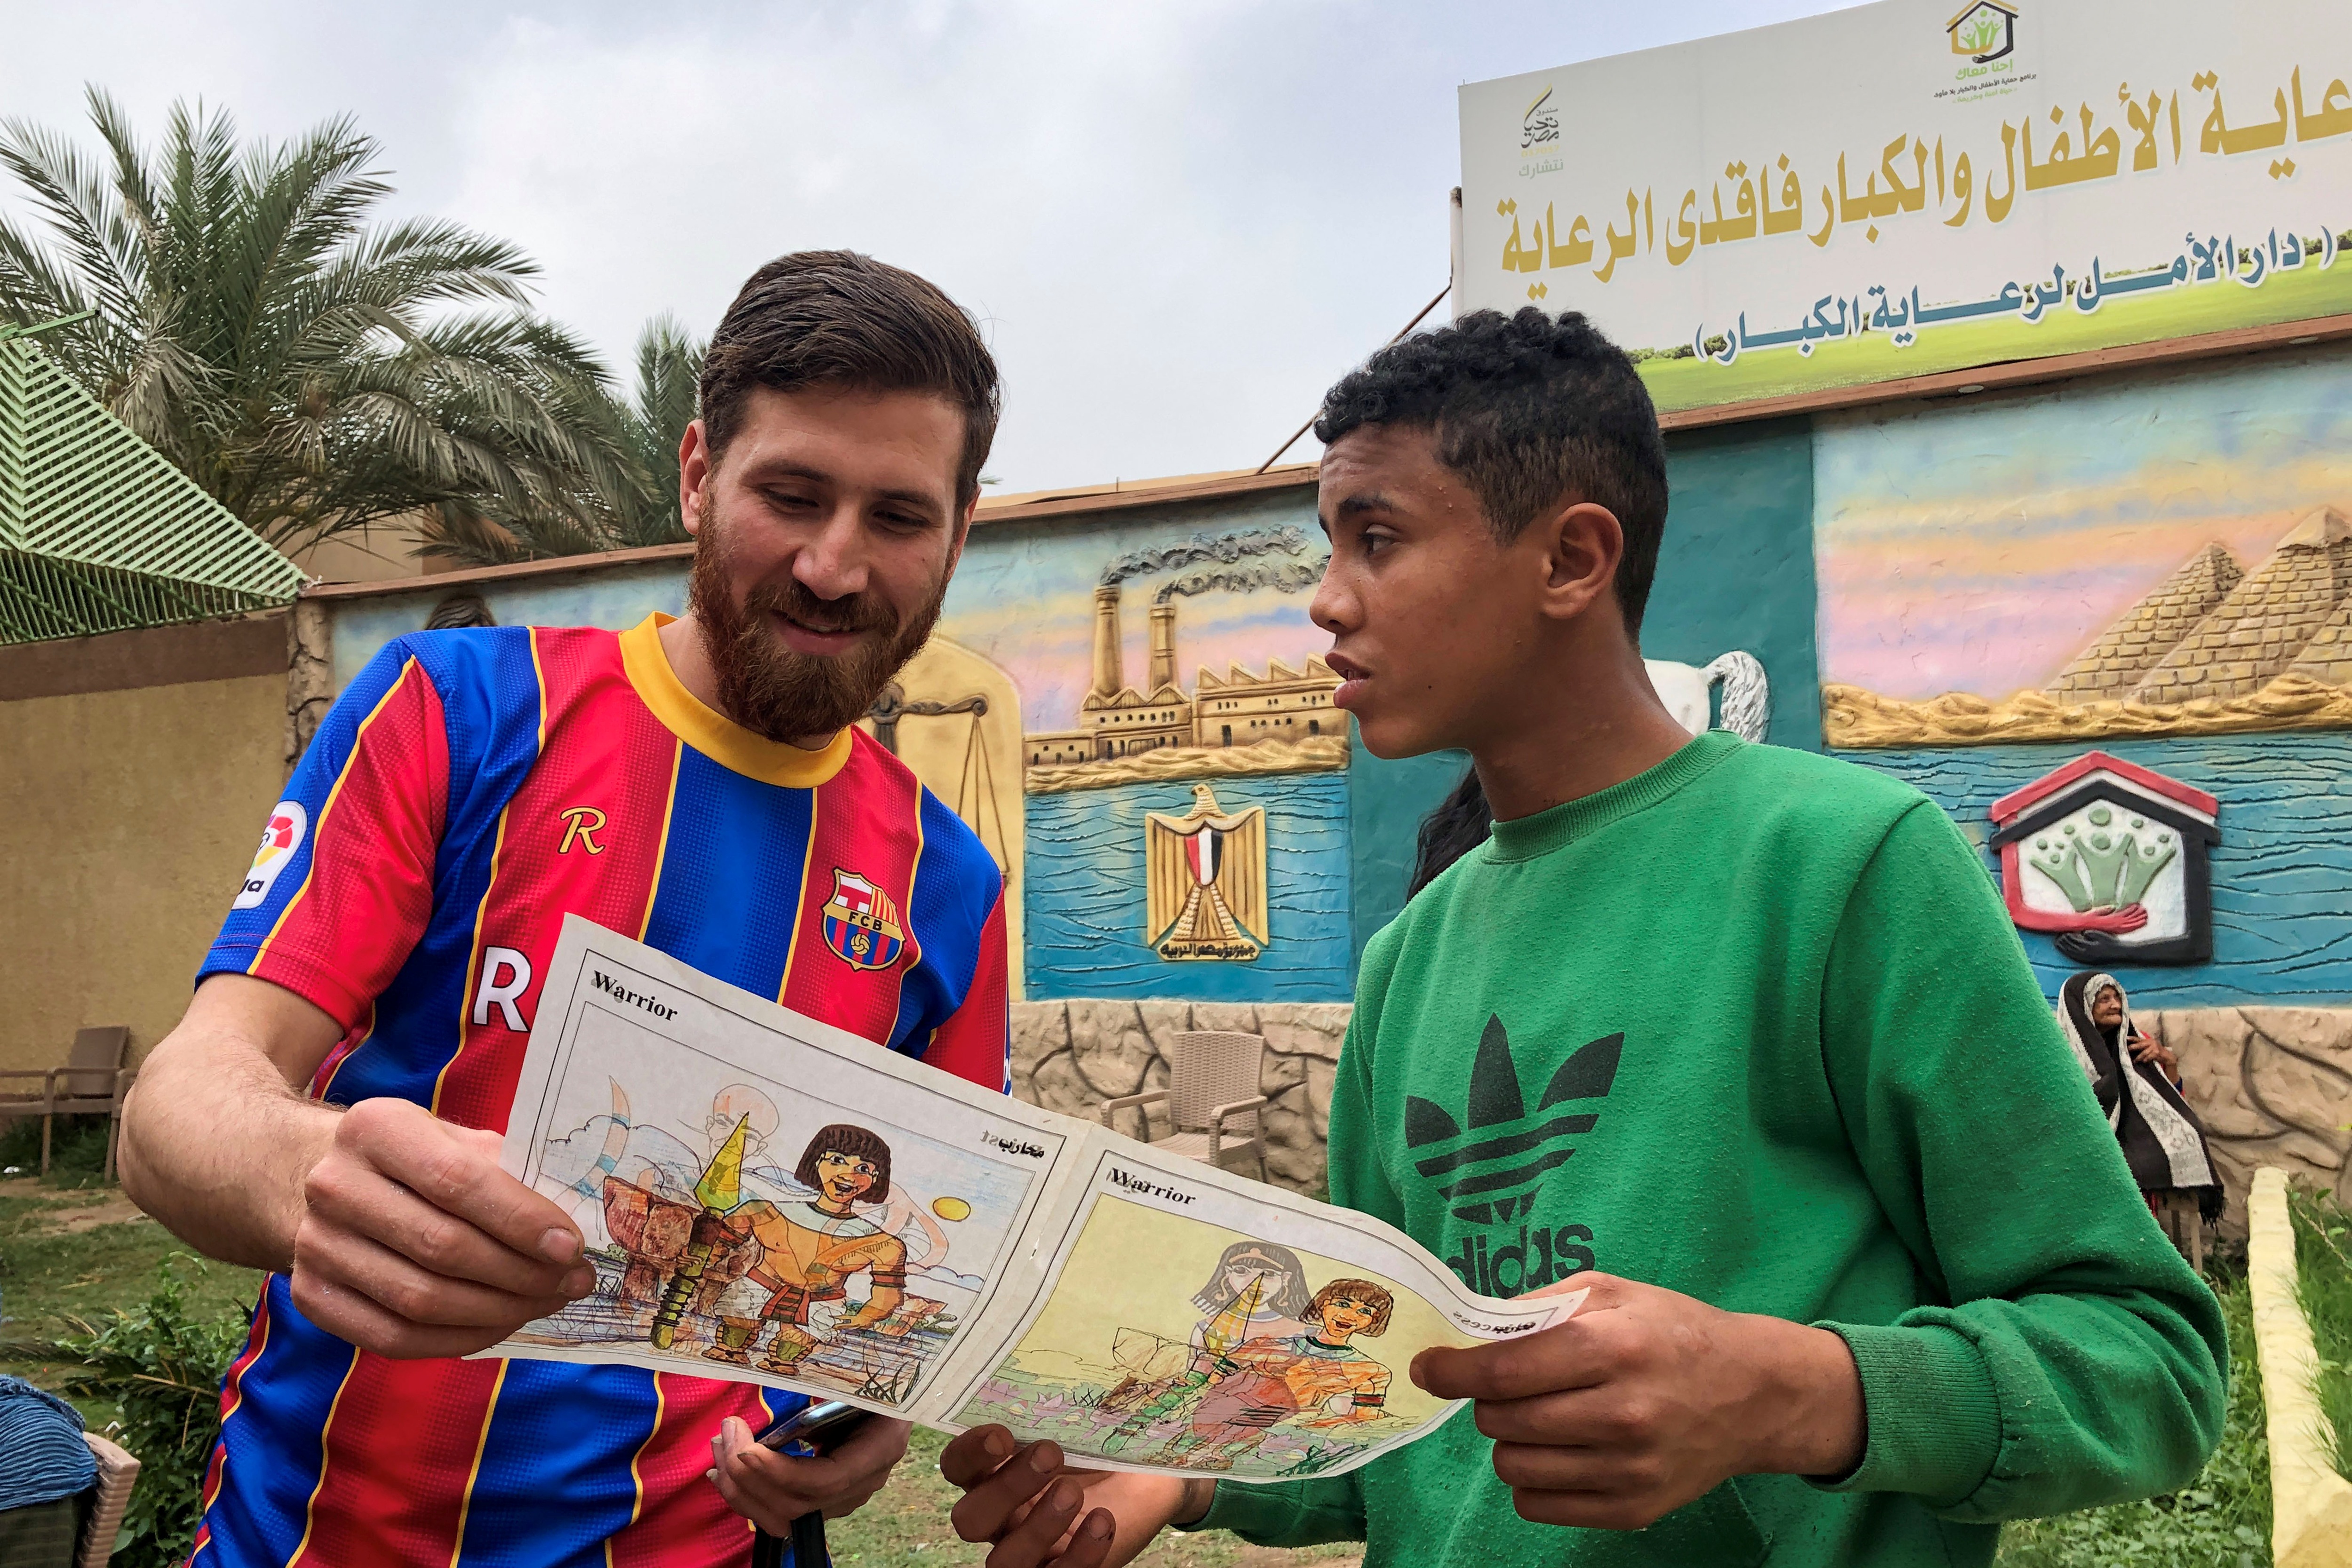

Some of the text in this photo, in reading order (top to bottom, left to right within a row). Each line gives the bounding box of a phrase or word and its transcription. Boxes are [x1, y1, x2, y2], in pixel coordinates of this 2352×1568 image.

[1955, 58, 2013, 80] إحنا معاك
[1979, 79, 2000, 90] الأطفال
[1957, 85, 1977, 95] والكبار
[1536, 107, 1558, 116] صندوق
[1521, 129, 1559, 149] مصر
[1497, 64, 2352, 301] عاية الأطفال والكبار فاقدى الرعاية
[1518, 159, 1564, 179] نتشارك
[2076, 231, 2233, 311] الأمل
[1867, 262, 2065, 343] لرعاية
[473, 945, 532, 1032] R
[594, 970, 678, 1021] Warrior
[1112, 1167, 1196, 1205] Warrior
[1446, 1224, 1595, 1299] didas
